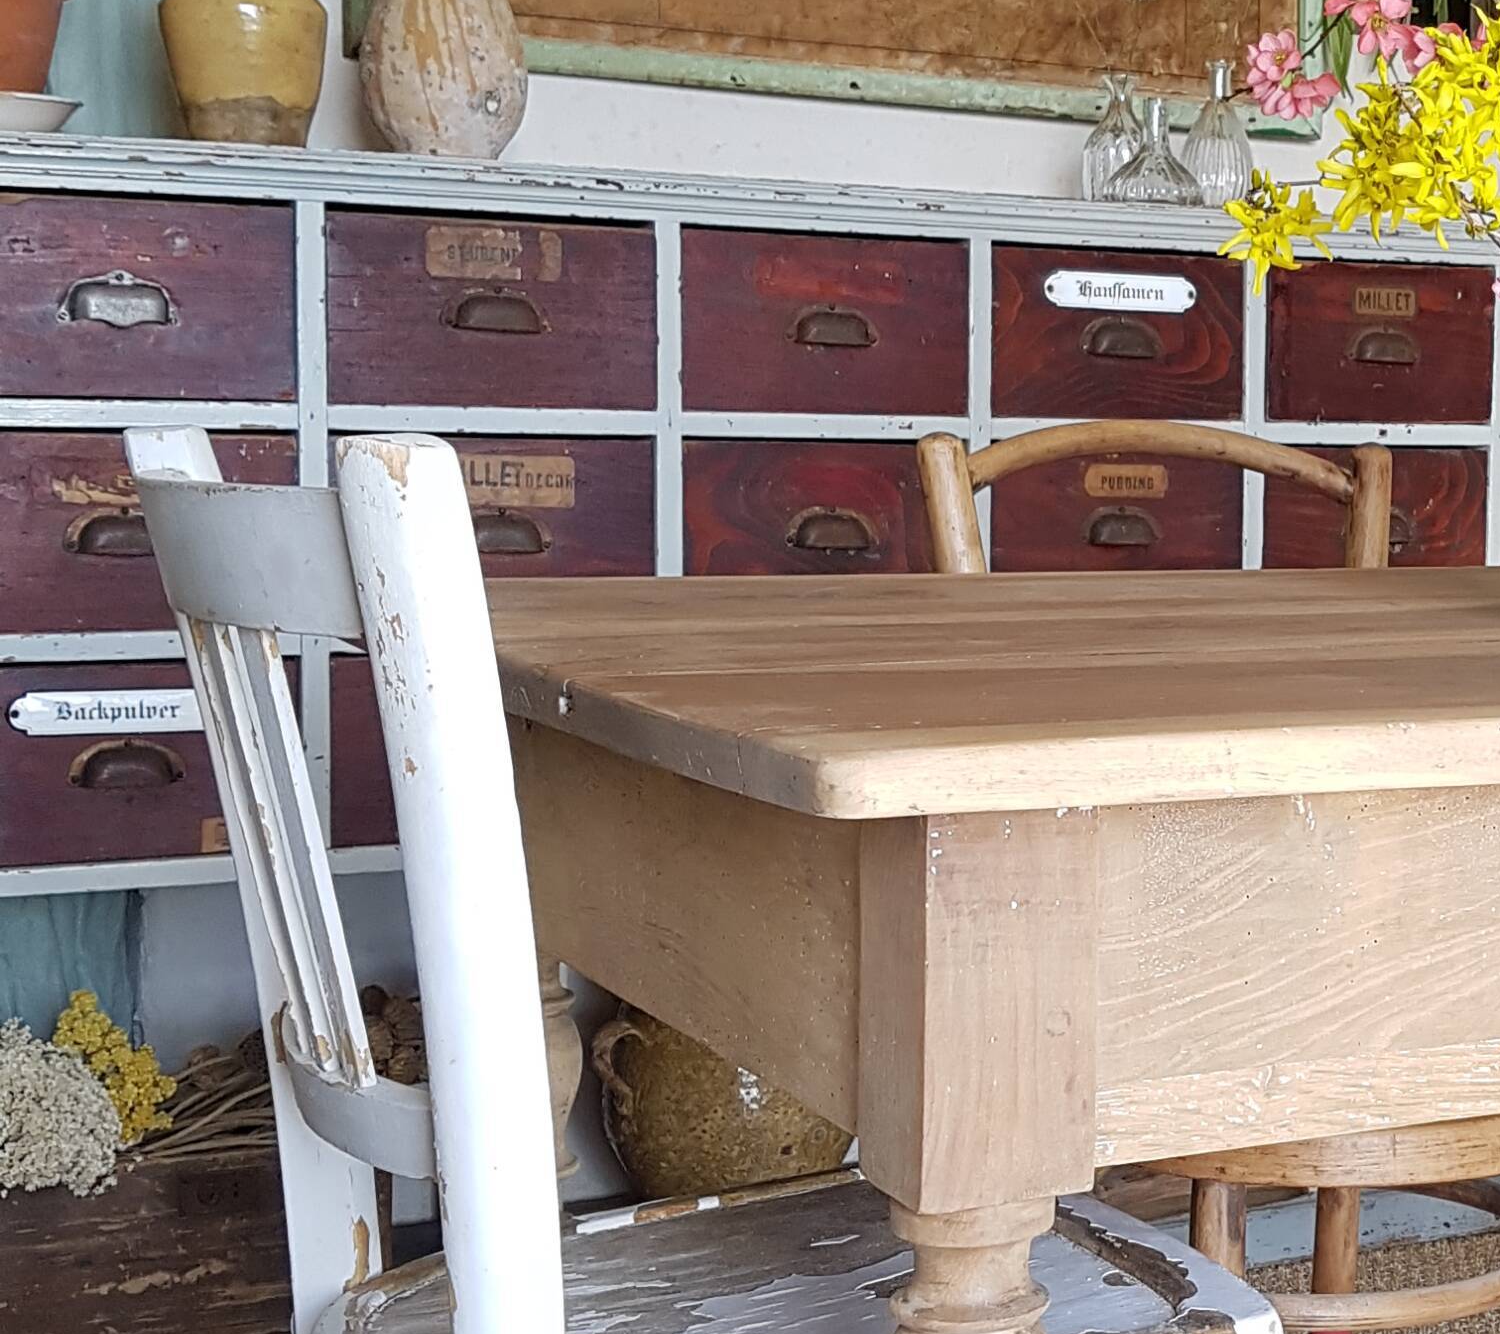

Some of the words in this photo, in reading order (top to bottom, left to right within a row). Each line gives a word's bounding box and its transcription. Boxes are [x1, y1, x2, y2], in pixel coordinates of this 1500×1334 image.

[1358, 290, 1412, 311] MILLET
[1101, 474, 1154, 491] PUDDING
[54, 700, 181, 723] Backpulver
